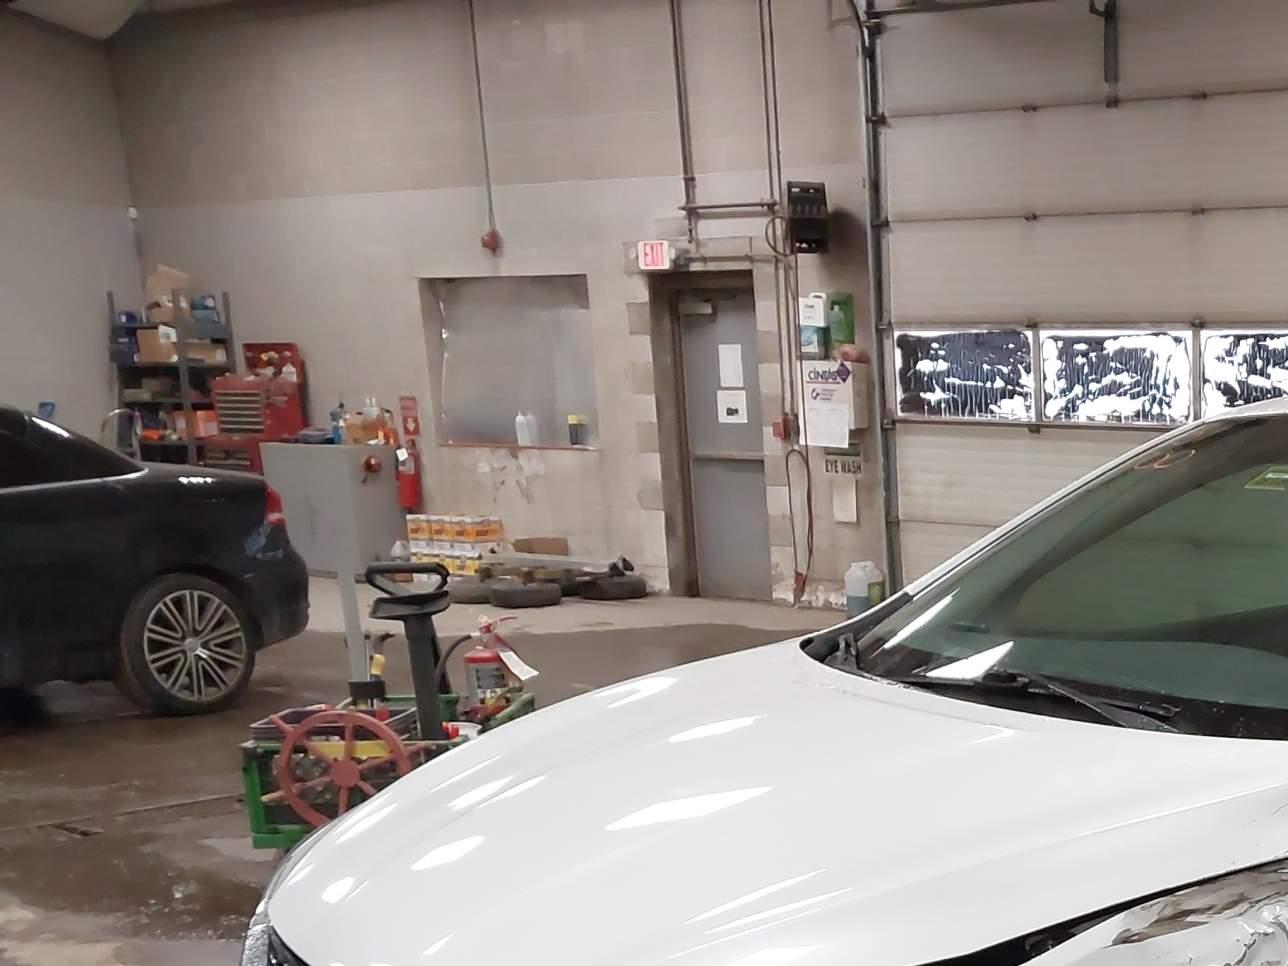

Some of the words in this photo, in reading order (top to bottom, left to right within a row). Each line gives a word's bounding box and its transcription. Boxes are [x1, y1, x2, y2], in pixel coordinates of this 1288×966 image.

[643, 242, 665, 267] EXIT
[825, 458, 839, 474] EYE
[840, 460, 862, 475] WASH
